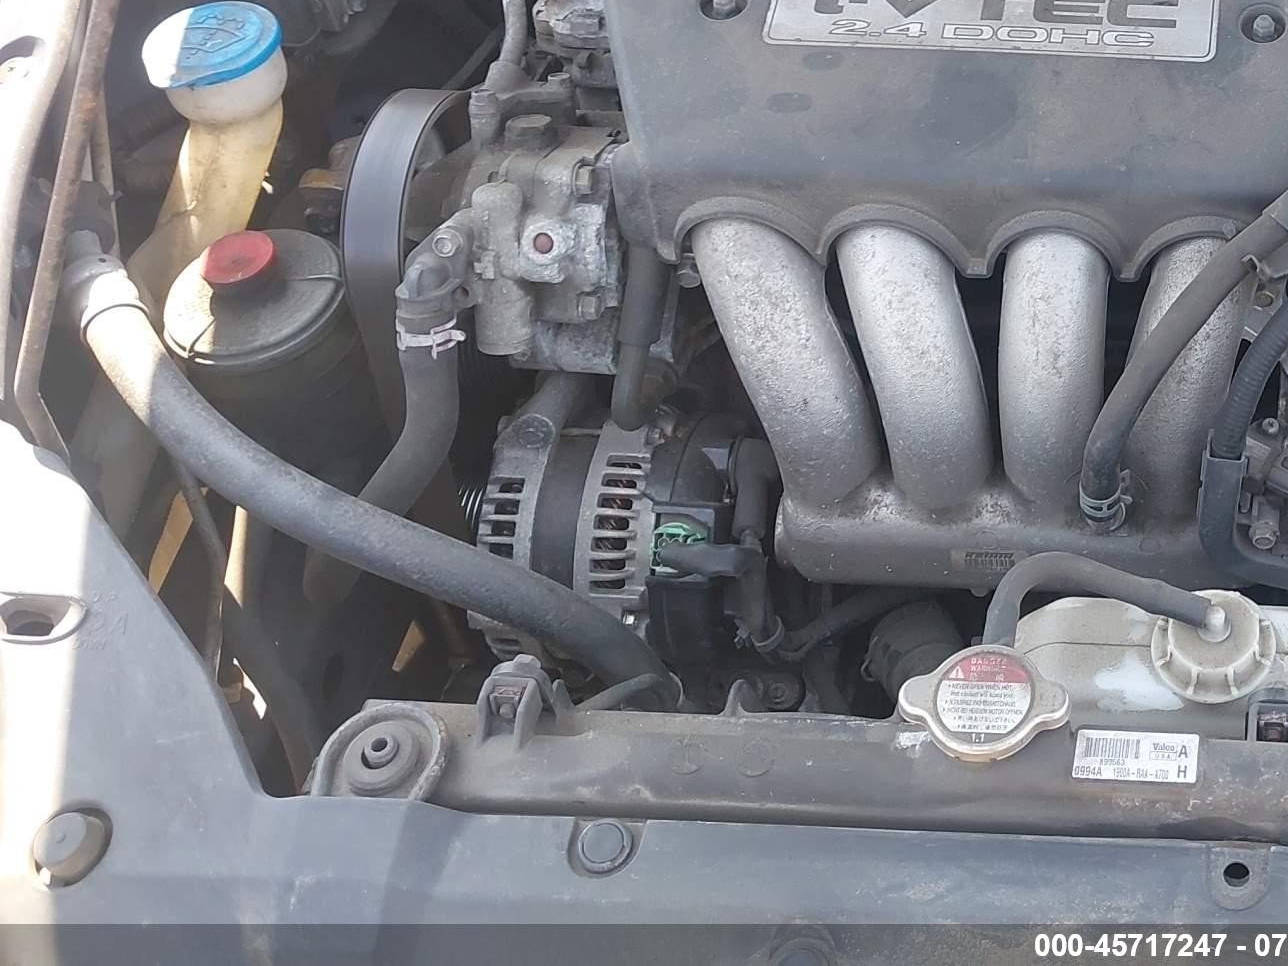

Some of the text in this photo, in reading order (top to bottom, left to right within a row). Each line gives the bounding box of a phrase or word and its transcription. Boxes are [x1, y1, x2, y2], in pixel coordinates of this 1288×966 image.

[831, 19, 1155, 48] 2.4 DOHC
[971, 733, 985, 742] 1.1
[1177, 744, 1189, 758] A
[1074, 766, 1102, 777] 0994A
[1177, 765, 1188, 779] H
